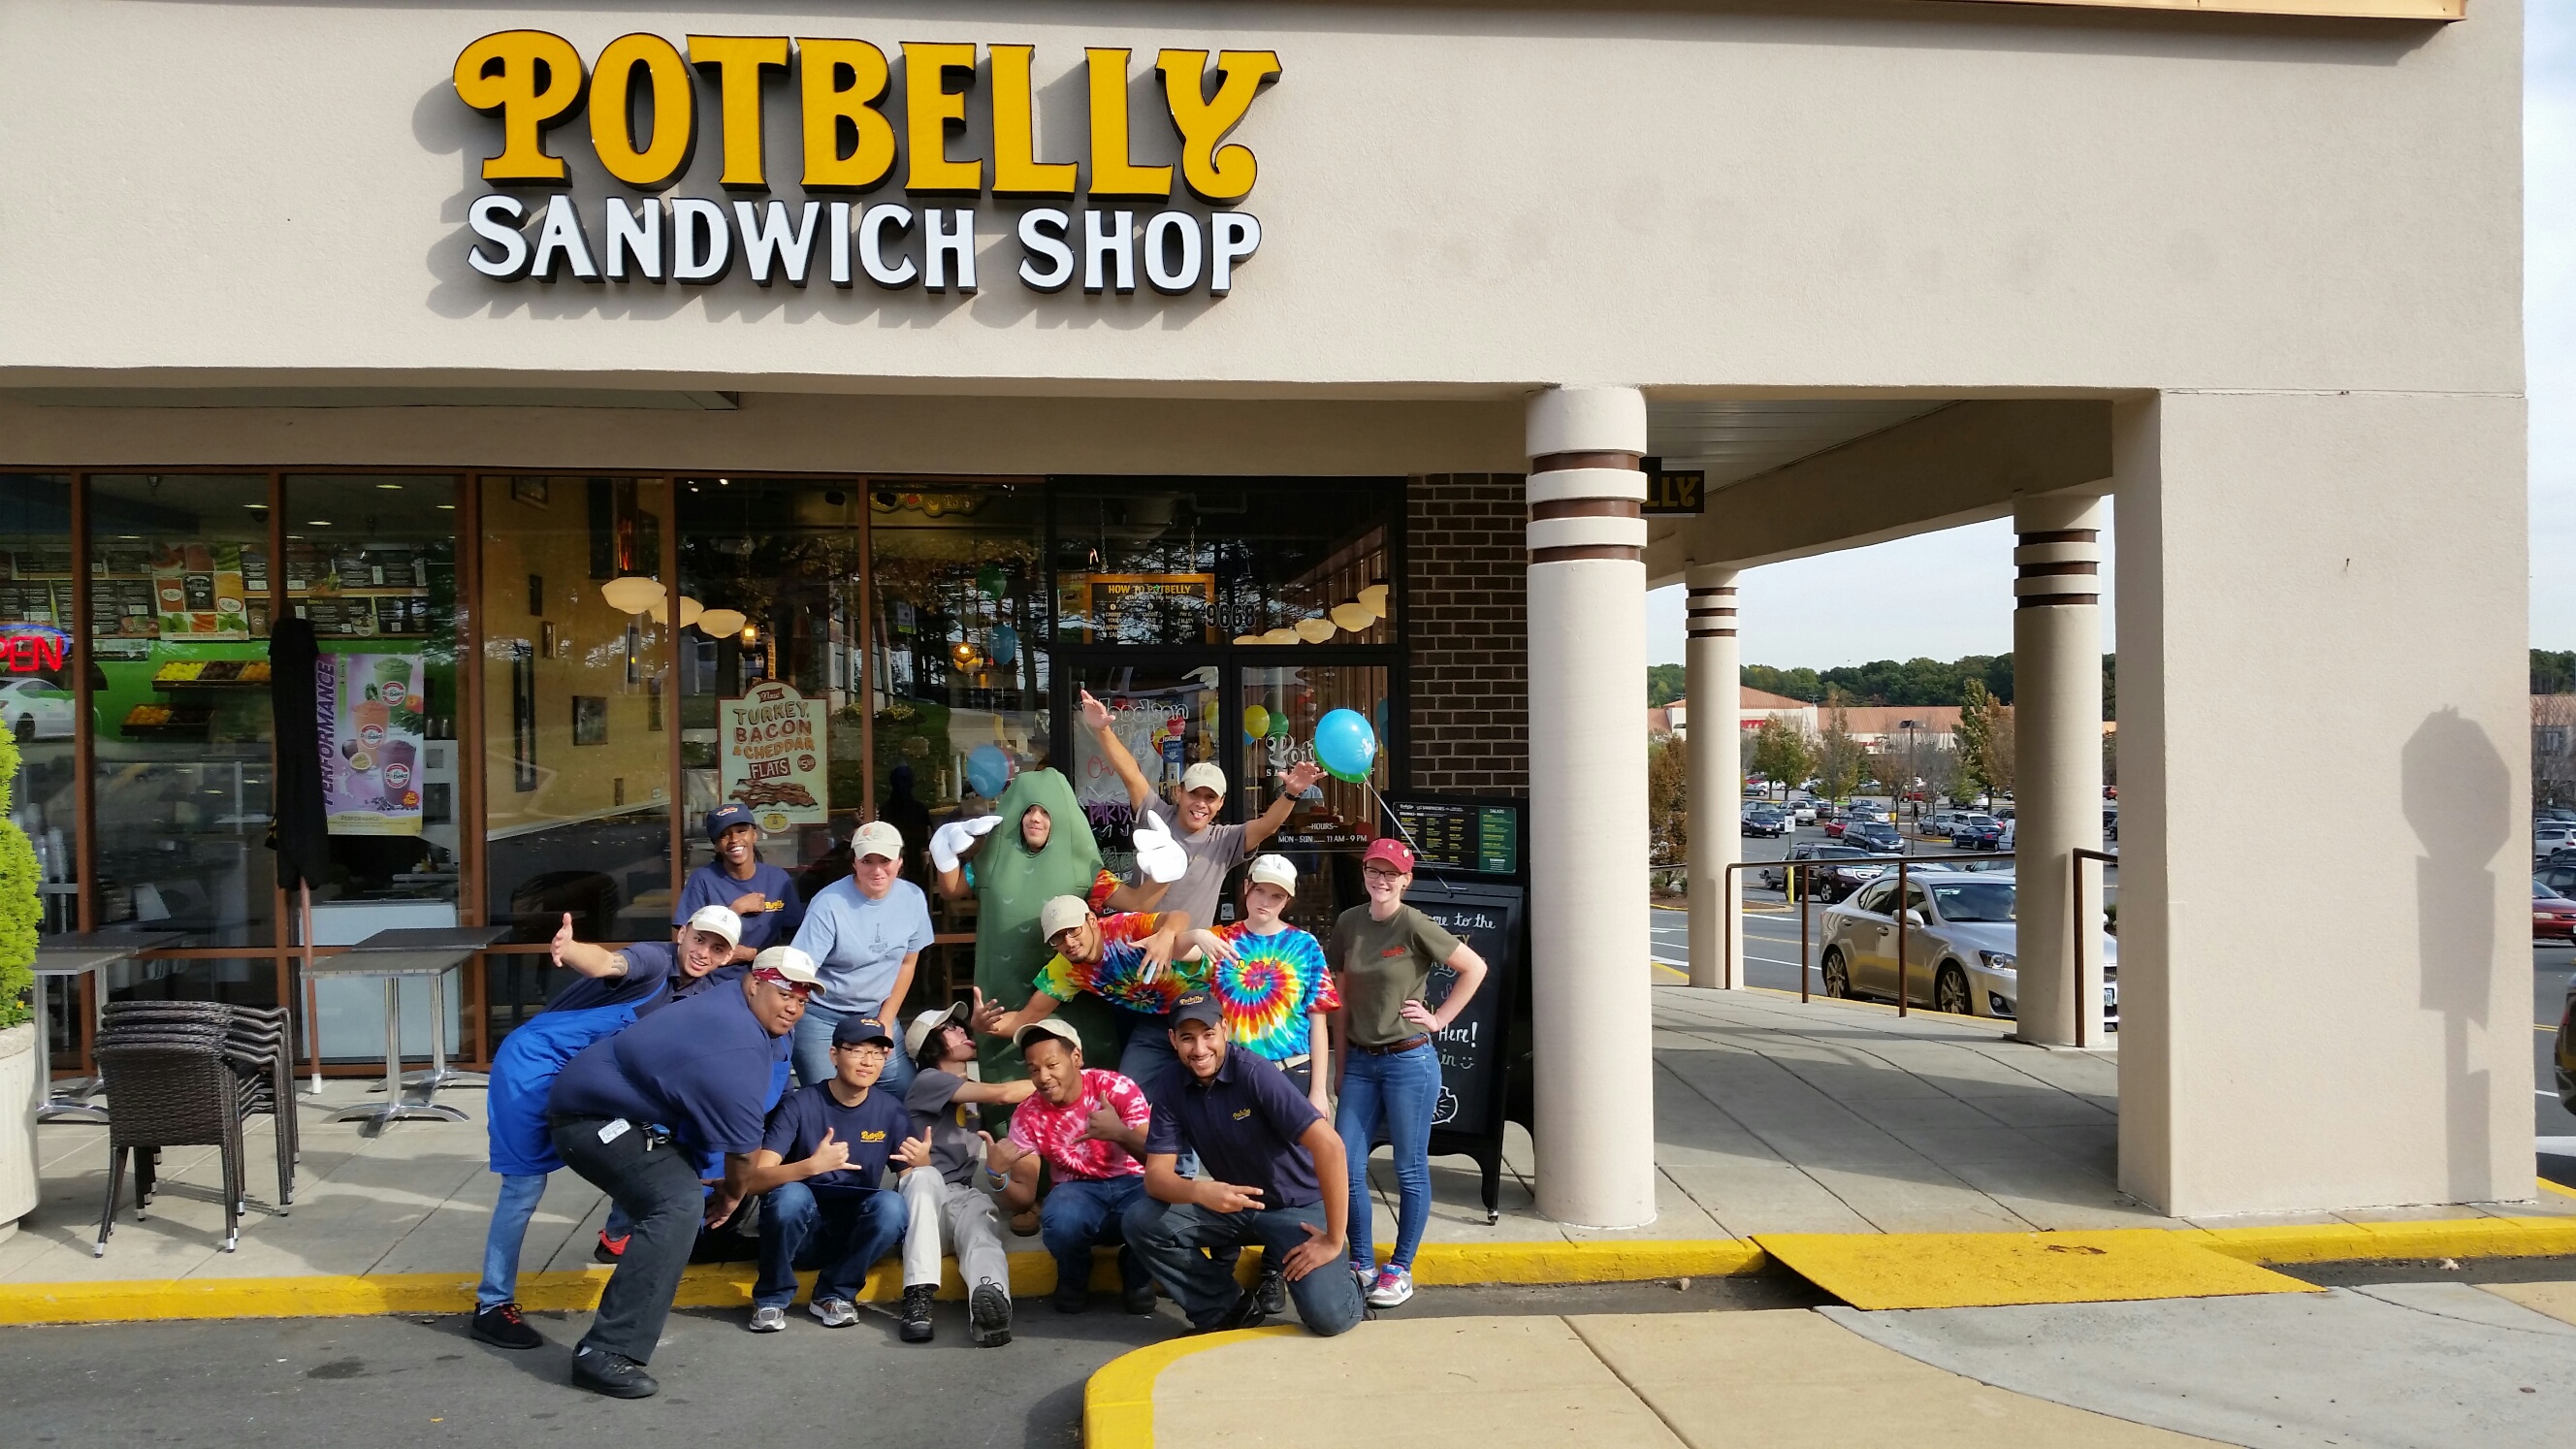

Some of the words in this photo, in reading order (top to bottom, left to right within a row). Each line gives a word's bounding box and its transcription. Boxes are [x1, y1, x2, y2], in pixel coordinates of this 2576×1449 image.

[453, 29, 1283, 204] POTBELLY
[467, 195, 978, 295] SANDWICH
[1018, 209, 1262, 297] SHOP
[1643, 476, 1700, 507] LLY
[1108, 585, 1130, 594] HOW
[1206, 603, 1256, 628] 9668
[733, 701, 810, 724] TURKEY,
[1080, 696, 1189, 723] oodson
[317, 661, 335, 806] PERFORMANCE
[733, 719, 813, 744] BACON
[744, 737, 815, 759] CHEDDAR
[752, 760, 789, 779] FLATS
[1088, 798, 1131, 825] PARTY
[1454, 912, 1472, 927] to
[1473, 913, 1497, 929] the
[1438, 1021, 1478, 1048] Here!
[1440, 1048, 1457, 1067] in
